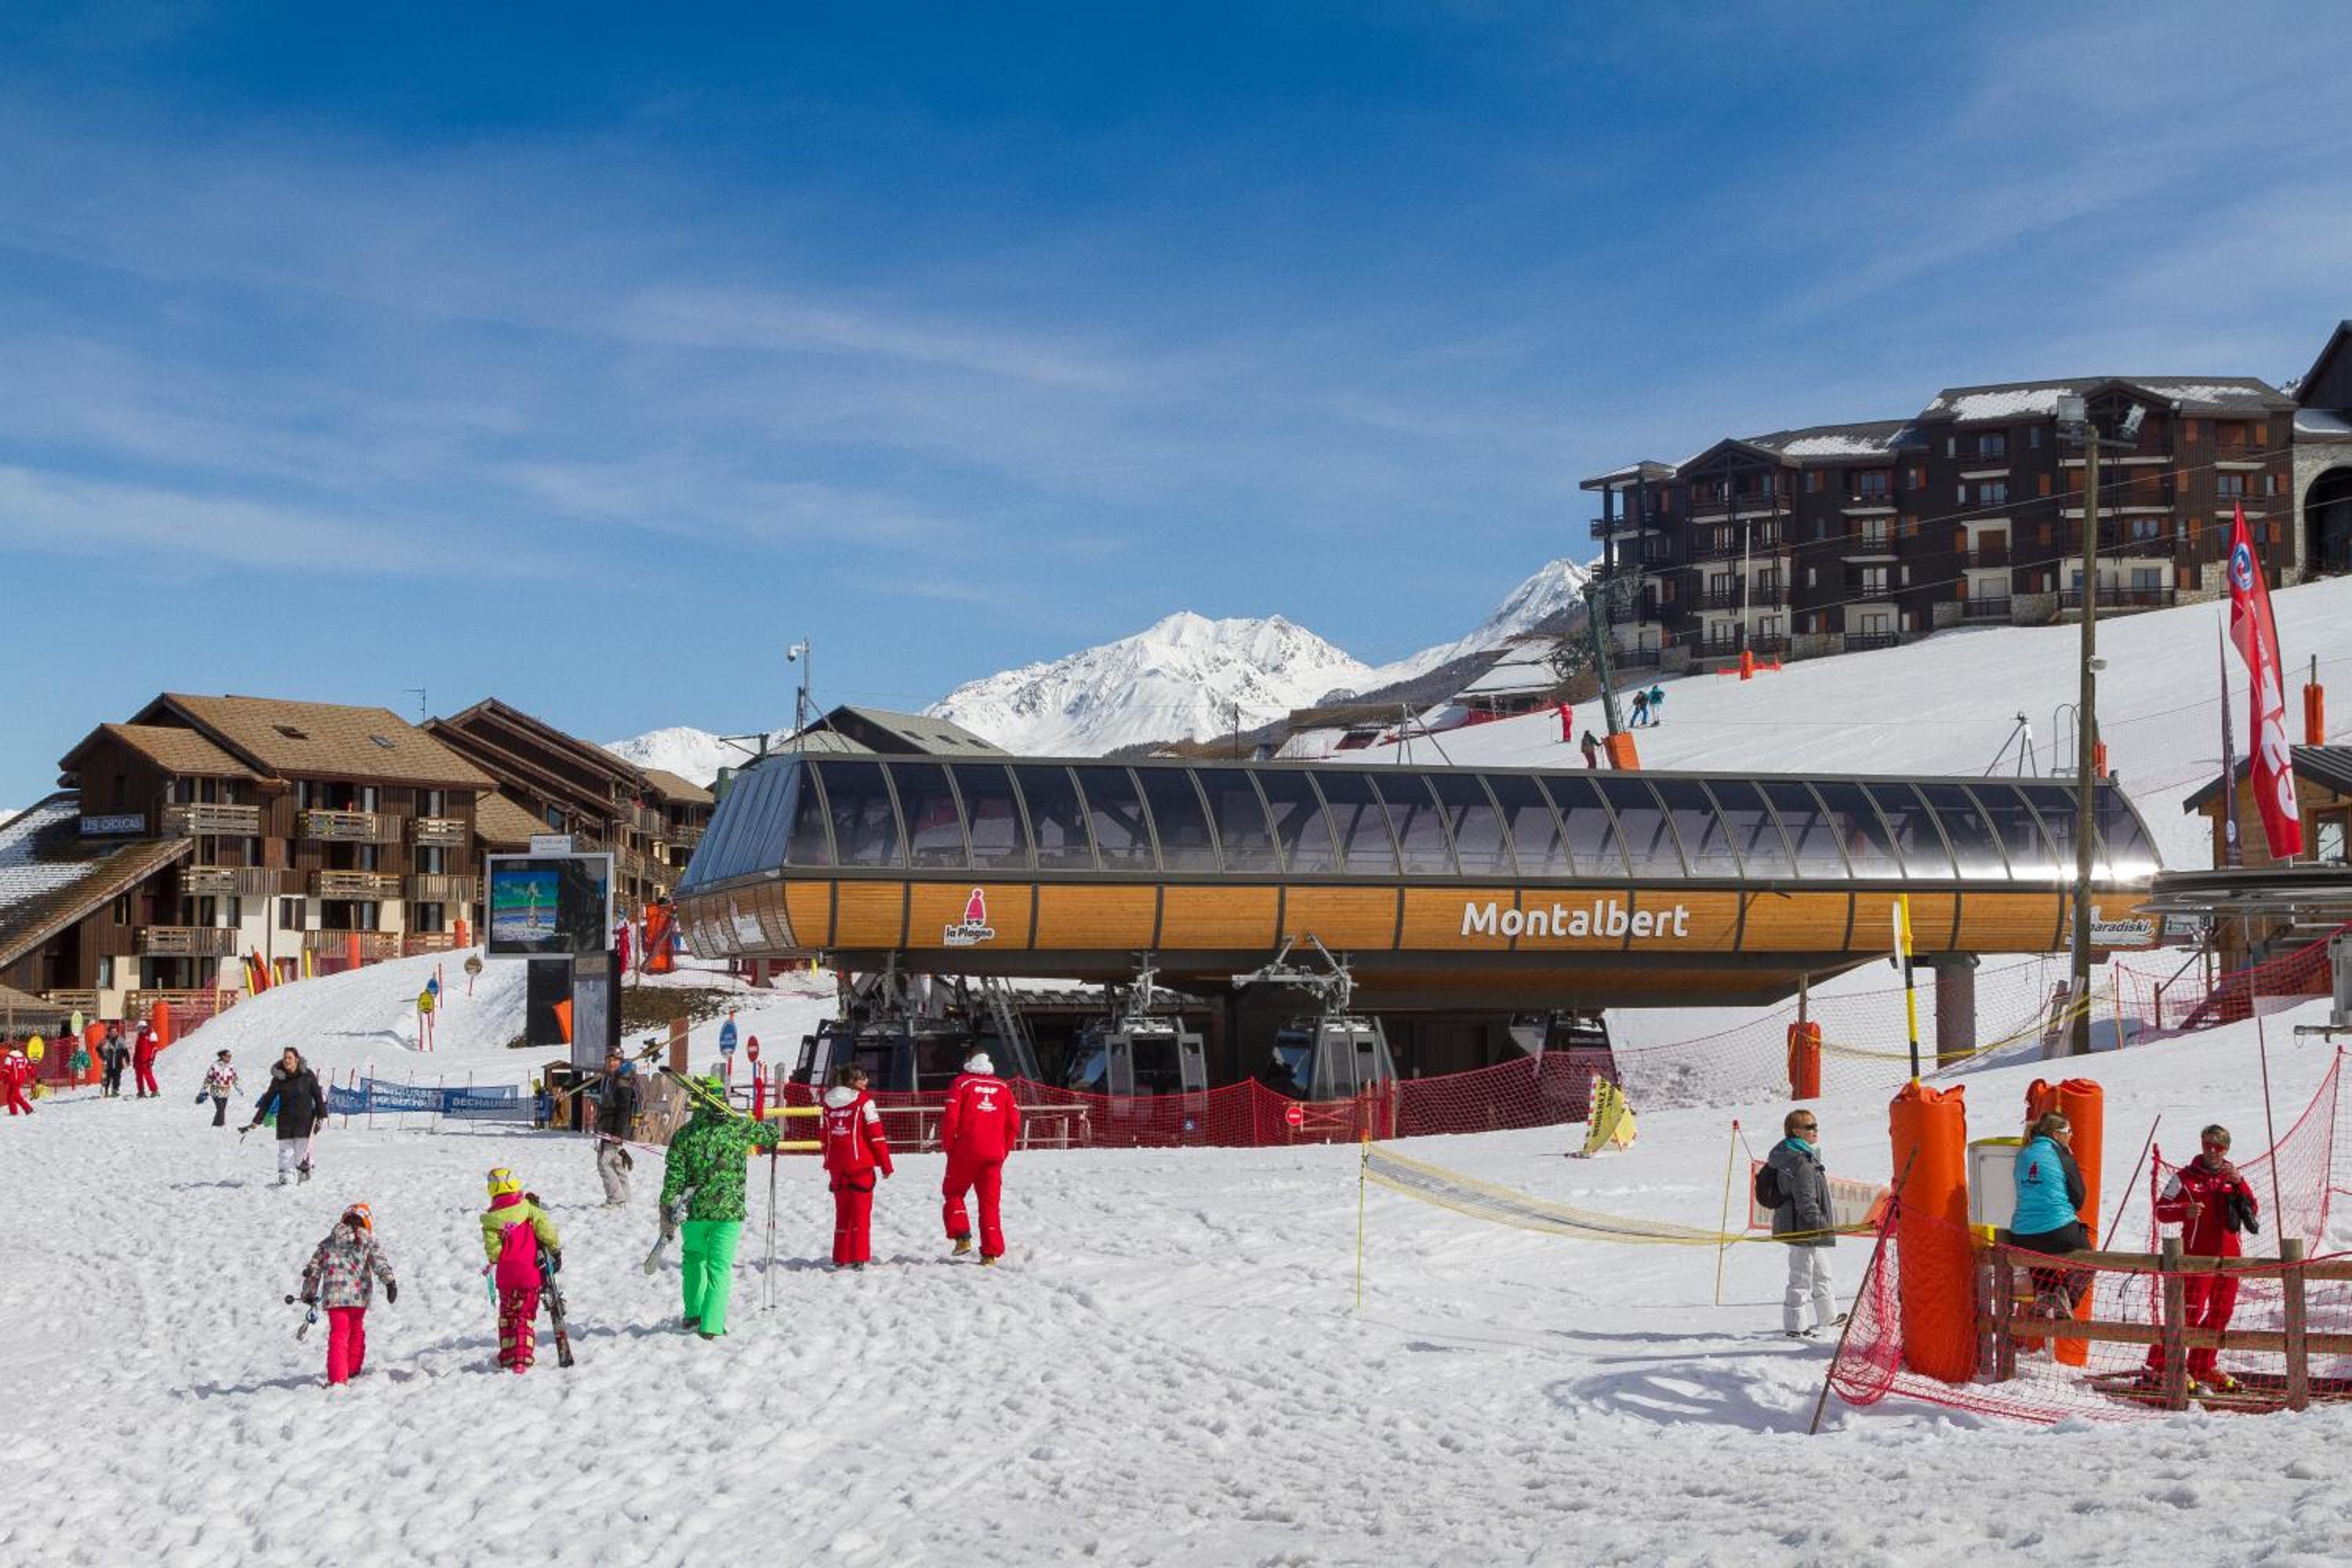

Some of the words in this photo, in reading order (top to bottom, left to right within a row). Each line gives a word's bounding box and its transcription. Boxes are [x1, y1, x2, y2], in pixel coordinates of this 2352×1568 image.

[82, 820, 98, 830] LES
[101, 818, 140, 829] CHOUCAS
[1461, 899, 1690, 937] Montalbert
[946, 926, 956, 937] la
[958, 927, 993, 940] Plagne
